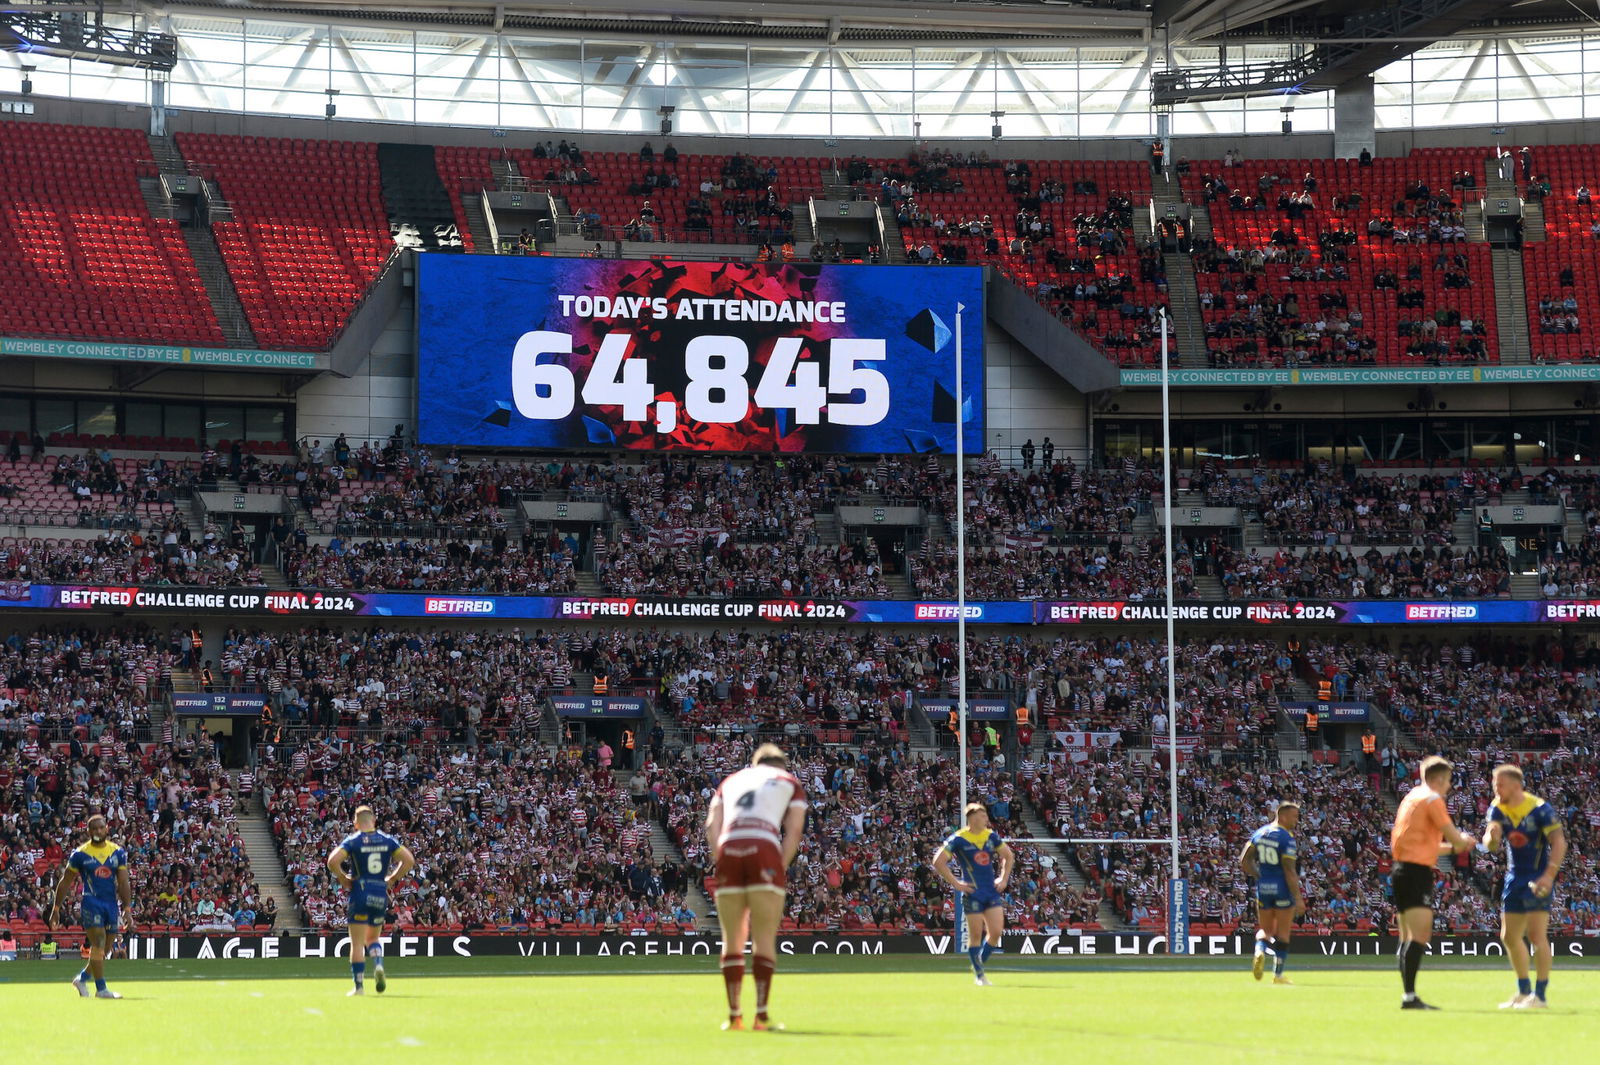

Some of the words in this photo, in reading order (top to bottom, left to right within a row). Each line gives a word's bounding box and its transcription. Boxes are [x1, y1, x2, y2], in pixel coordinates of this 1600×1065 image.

[558, 294, 668, 320] TODAY'S
[675, 298, 846, 323] ATTENDANCE
[5, 341, 64, 355] WEMBLEY
[67, 344, 147, 359] CONNECTED
[148, 348, 164, 359] BY
[166, 349, 180, 359] EE
[194, 351, 252, 363] WEMBLEY
[255, 353, 314, 366] CONNECT
[511, 330, 890, 434] 64,845
[1182, 372, 1256, 382] CONNECTED
[1257, 372, 1273, 382] BY
[1275, 371, 1288, 382] EE
[1302, 371, 1359, 382] WEMBLEY
[1361, 371, 1437, 381] CONNECTED
[1439, 370, 1455, 380] BY
[1456, 370, 1470, 380] EE
[1484, 369, 1542, 380] WEMBLEY
[61, 590, 130, 605] BETFRED
[136, 592, 224, 608] CHALLENGE
[230, 594, 258, 609] CUP
[264, 595, 309, 610] FINAL
[315, 595, 354, 611] 2024
[427, 600, 493, 613] BETFRED
[563, 602, 629, 615] BETFRED
[634, 603, 719, 617] CHALLENGE
[725, 604, 753, 617] CUP
[759, 605, 802, 618] FINAL
[807, 605, 846, 618] 2024
[1051, 606, 1117, 619] BETFRED
[1122, 606, 1209, 619] CHALLENGE
[1213, 606, 1241, 619] CUP
[1247, 606, 1291, 619] FINAL
[1296, 606, 1336, 619] 2024
[1409, 606, 1477, 618] BETFRED
[1335, 708, 1365, 716] BETFRED
[735, 789, 757, 812] 4
[1257, 844, 1279, 865] 10
[368, 853, 383, 875] 6
[1173, 880, 1185, 954] BETFRED
[104, 936, 280, 960] ILLAGE
[1115, 935, 1275, 956] HOTEL
